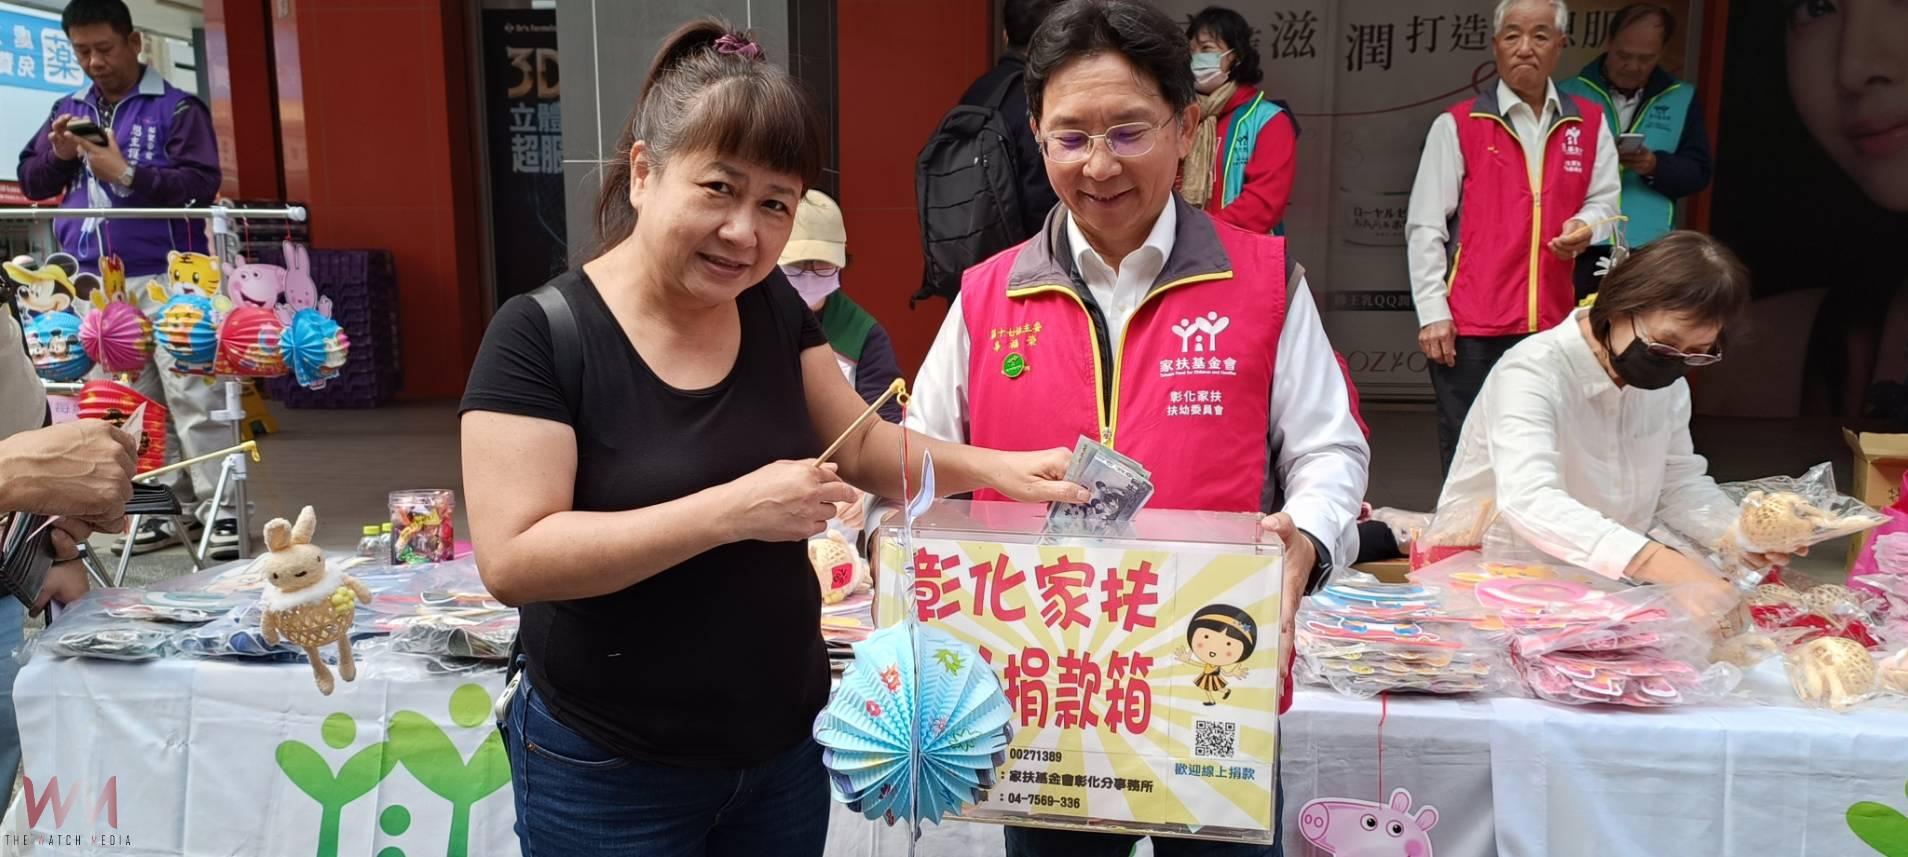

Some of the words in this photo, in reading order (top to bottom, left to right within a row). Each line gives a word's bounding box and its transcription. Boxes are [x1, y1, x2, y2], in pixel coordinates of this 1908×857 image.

[505, 47, 560, 99] 3D
[1159, 356, 1237, 372] 家扶基金會
[1170, 390, 1222, 402] 彰化家扶
[1167, 404, 1224, 416] 扶幼委員會
[914, 546, 1160, 633] 彰化家扶
[1009, 748, 1063, 762] 00271389
[1174, 763, 1256, 780] 歡迎線上捐款
